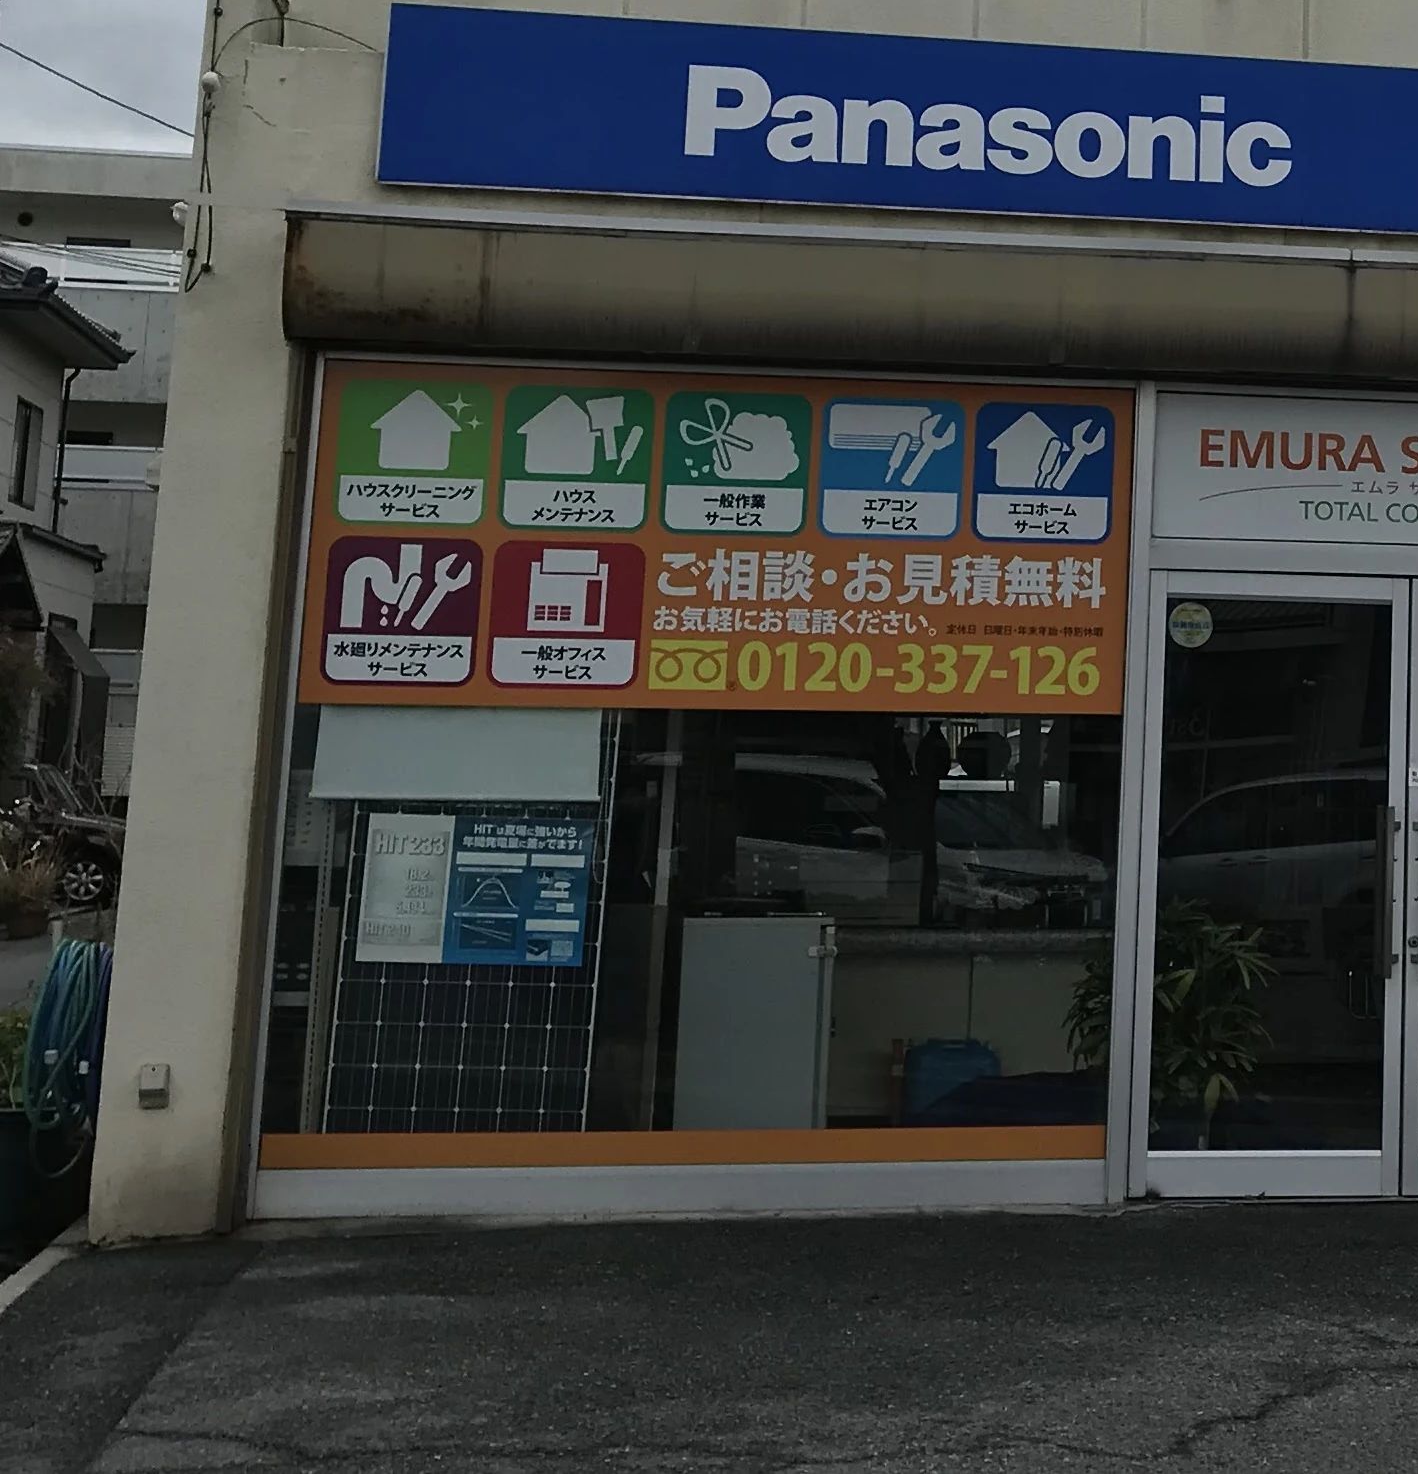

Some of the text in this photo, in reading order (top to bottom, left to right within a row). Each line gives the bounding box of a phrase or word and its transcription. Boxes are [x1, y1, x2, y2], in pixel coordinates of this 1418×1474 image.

[684, 63, 1293, 188] Panasonic
[1200, 428, 1386, 474] EMURA
[346, 483, 477, 501] ハウスクリーニング
[1350, 480, 1400, 495] エムラ
[553, 489, 597, 504] ハウス
[703, 494, 766, 511] 一般作業
[380, 502, 440, 519] サービス
[863, 497, 919, 514] エアコン
[1008, 501, 1078, 518] エコホーム
[1299, 500, 1379, 523] TOTAL
[531, 507, 616, 524] メンテナンス
[704, 511, 763, 527] サービス
[861, 515, 919, 532] サービス
[1014, 519, 1071, 535] サービス
[656, 548, 1107, 609] ご相談・お見積無料
[652, 606, 938, 638] お気軽にお電話ください。
[333, 641, 464, 659] 水廻りメンテナンス
[521, 646, 607, 662] 一般オフィス
[367, 661, 428, 679] サービス
[532, 664, 593, 681] サービス
[737, 640, 1101, 696] 0120-337-126
